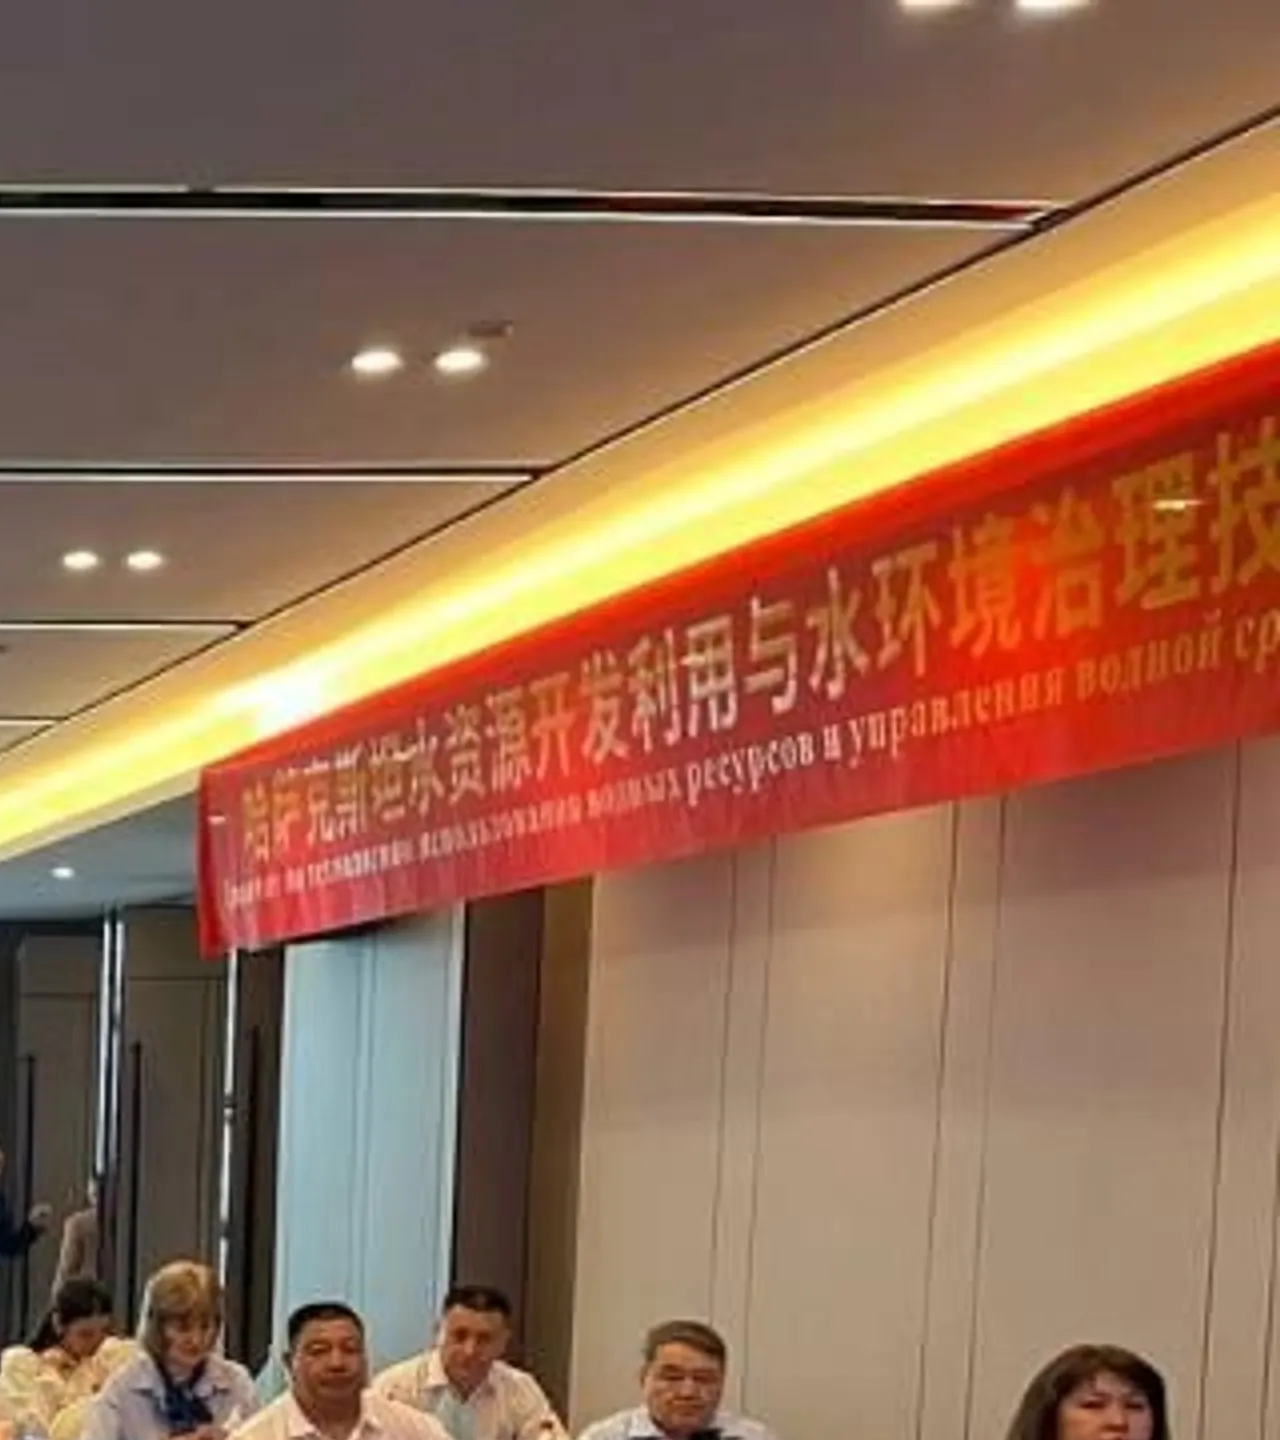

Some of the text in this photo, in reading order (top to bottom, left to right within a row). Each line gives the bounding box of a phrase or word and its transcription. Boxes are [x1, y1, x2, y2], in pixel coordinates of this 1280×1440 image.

[686, 732, 814, 807] ресурсов
[823, 723, 842, 761] и
[848, 666, 1065, 769] управления
